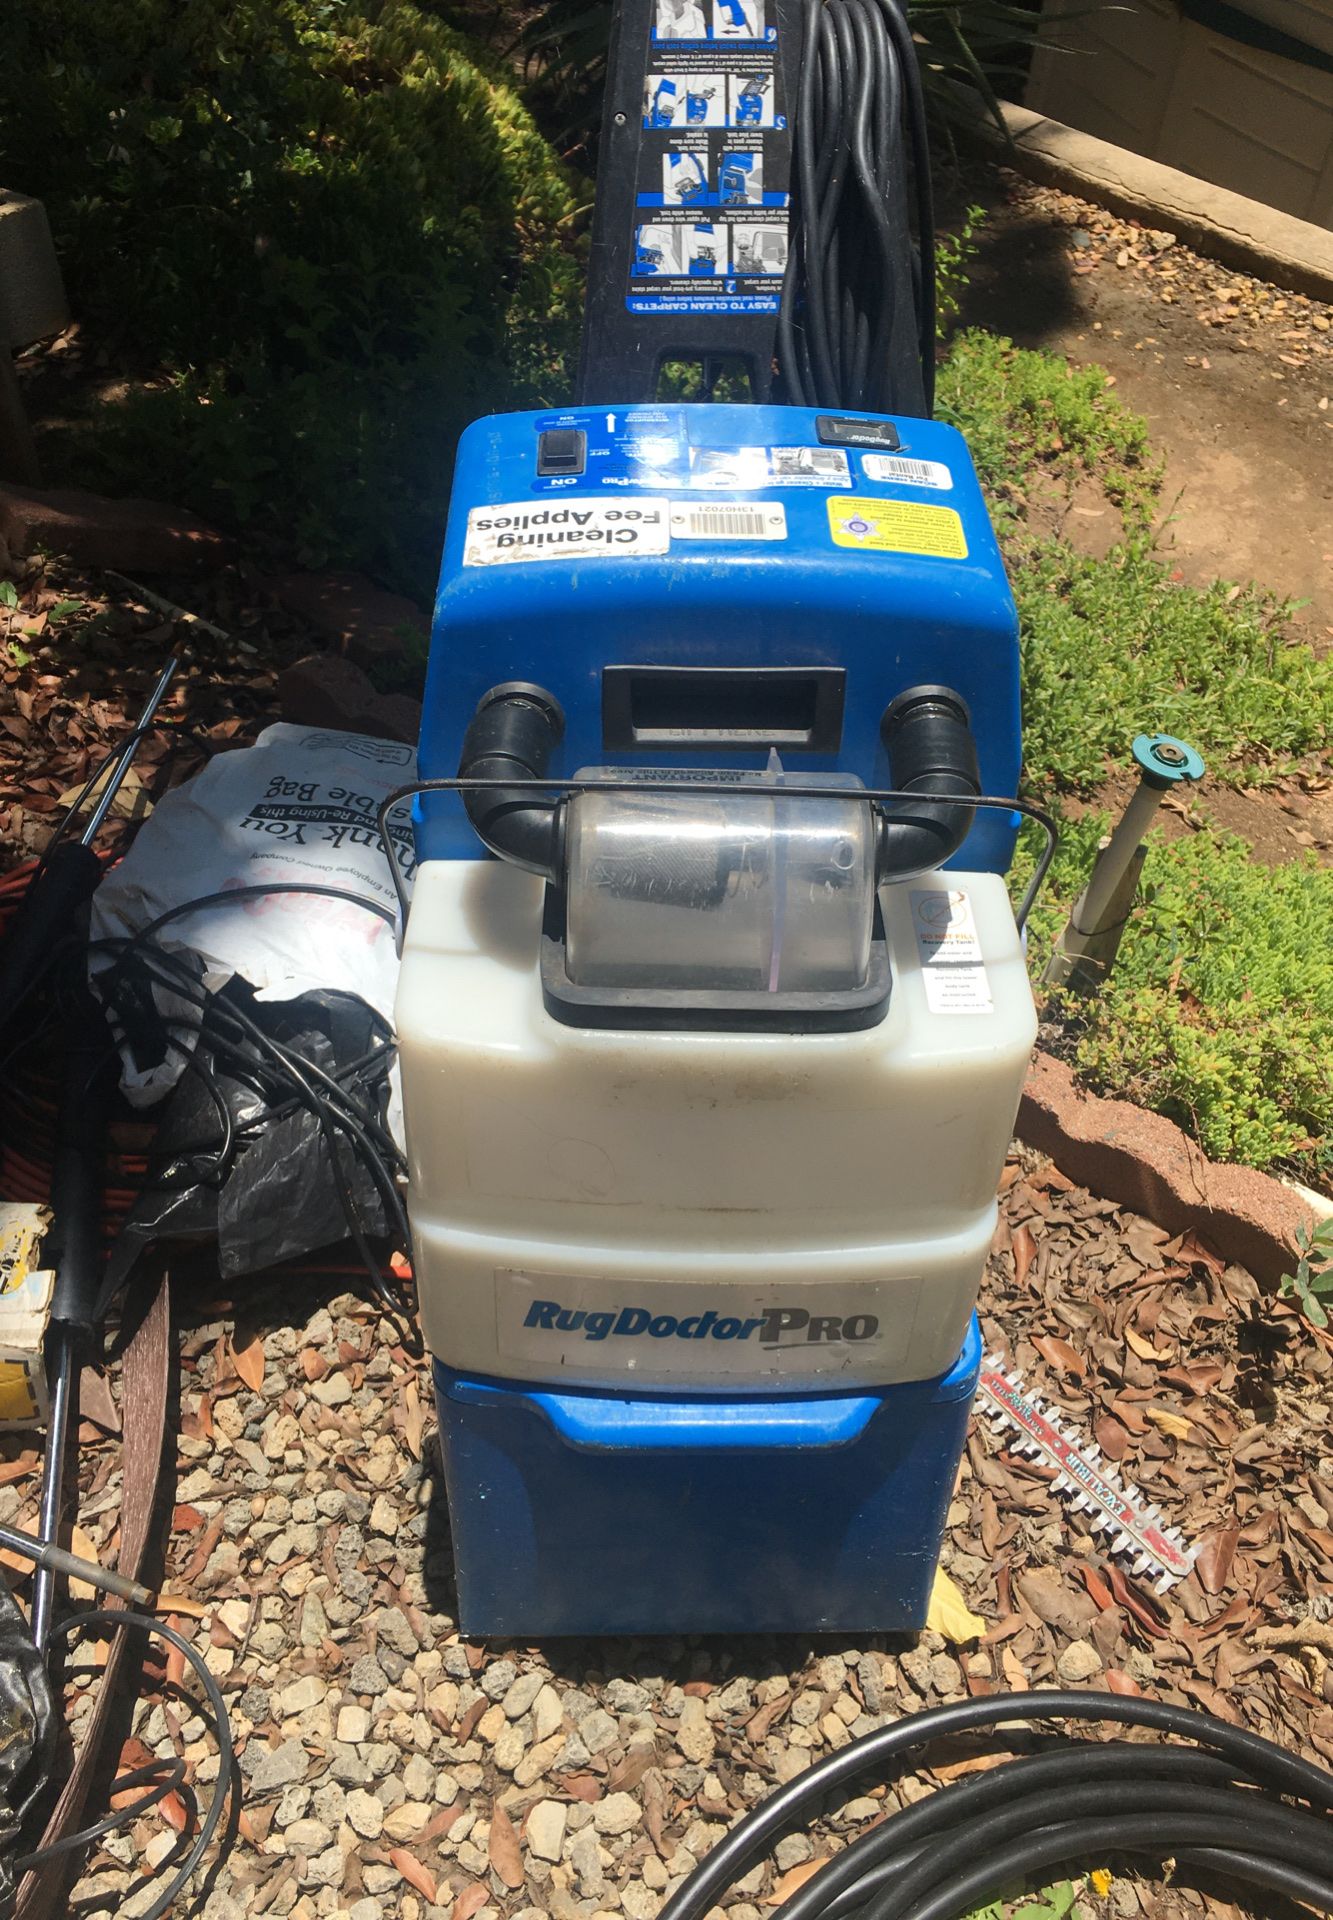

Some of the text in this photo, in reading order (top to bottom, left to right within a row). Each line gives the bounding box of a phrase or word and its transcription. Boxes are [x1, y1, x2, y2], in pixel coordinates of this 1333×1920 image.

[632, 302, 777, 310] EASY TO CLEAN CARPETS:
[550, 477, 578, 486] ON
[476, 510, 661, 531] Fee Applies
[497, 528, 639, 549] Cleaning
[632, 774, 741, 782] IMPORTANT
[263, 776, 321, 803] Bag
[259, 806, 286, 819] this
[289, 806, 351, 823] Re-Using
[238, 817, 308, 845] You
[249, 851, 296, 865] Company
[335, 866, 383, 892] Employee
[384, 888, 398, 901] An
[1064, 1452, 1127, 1516] EXCALIBUR
